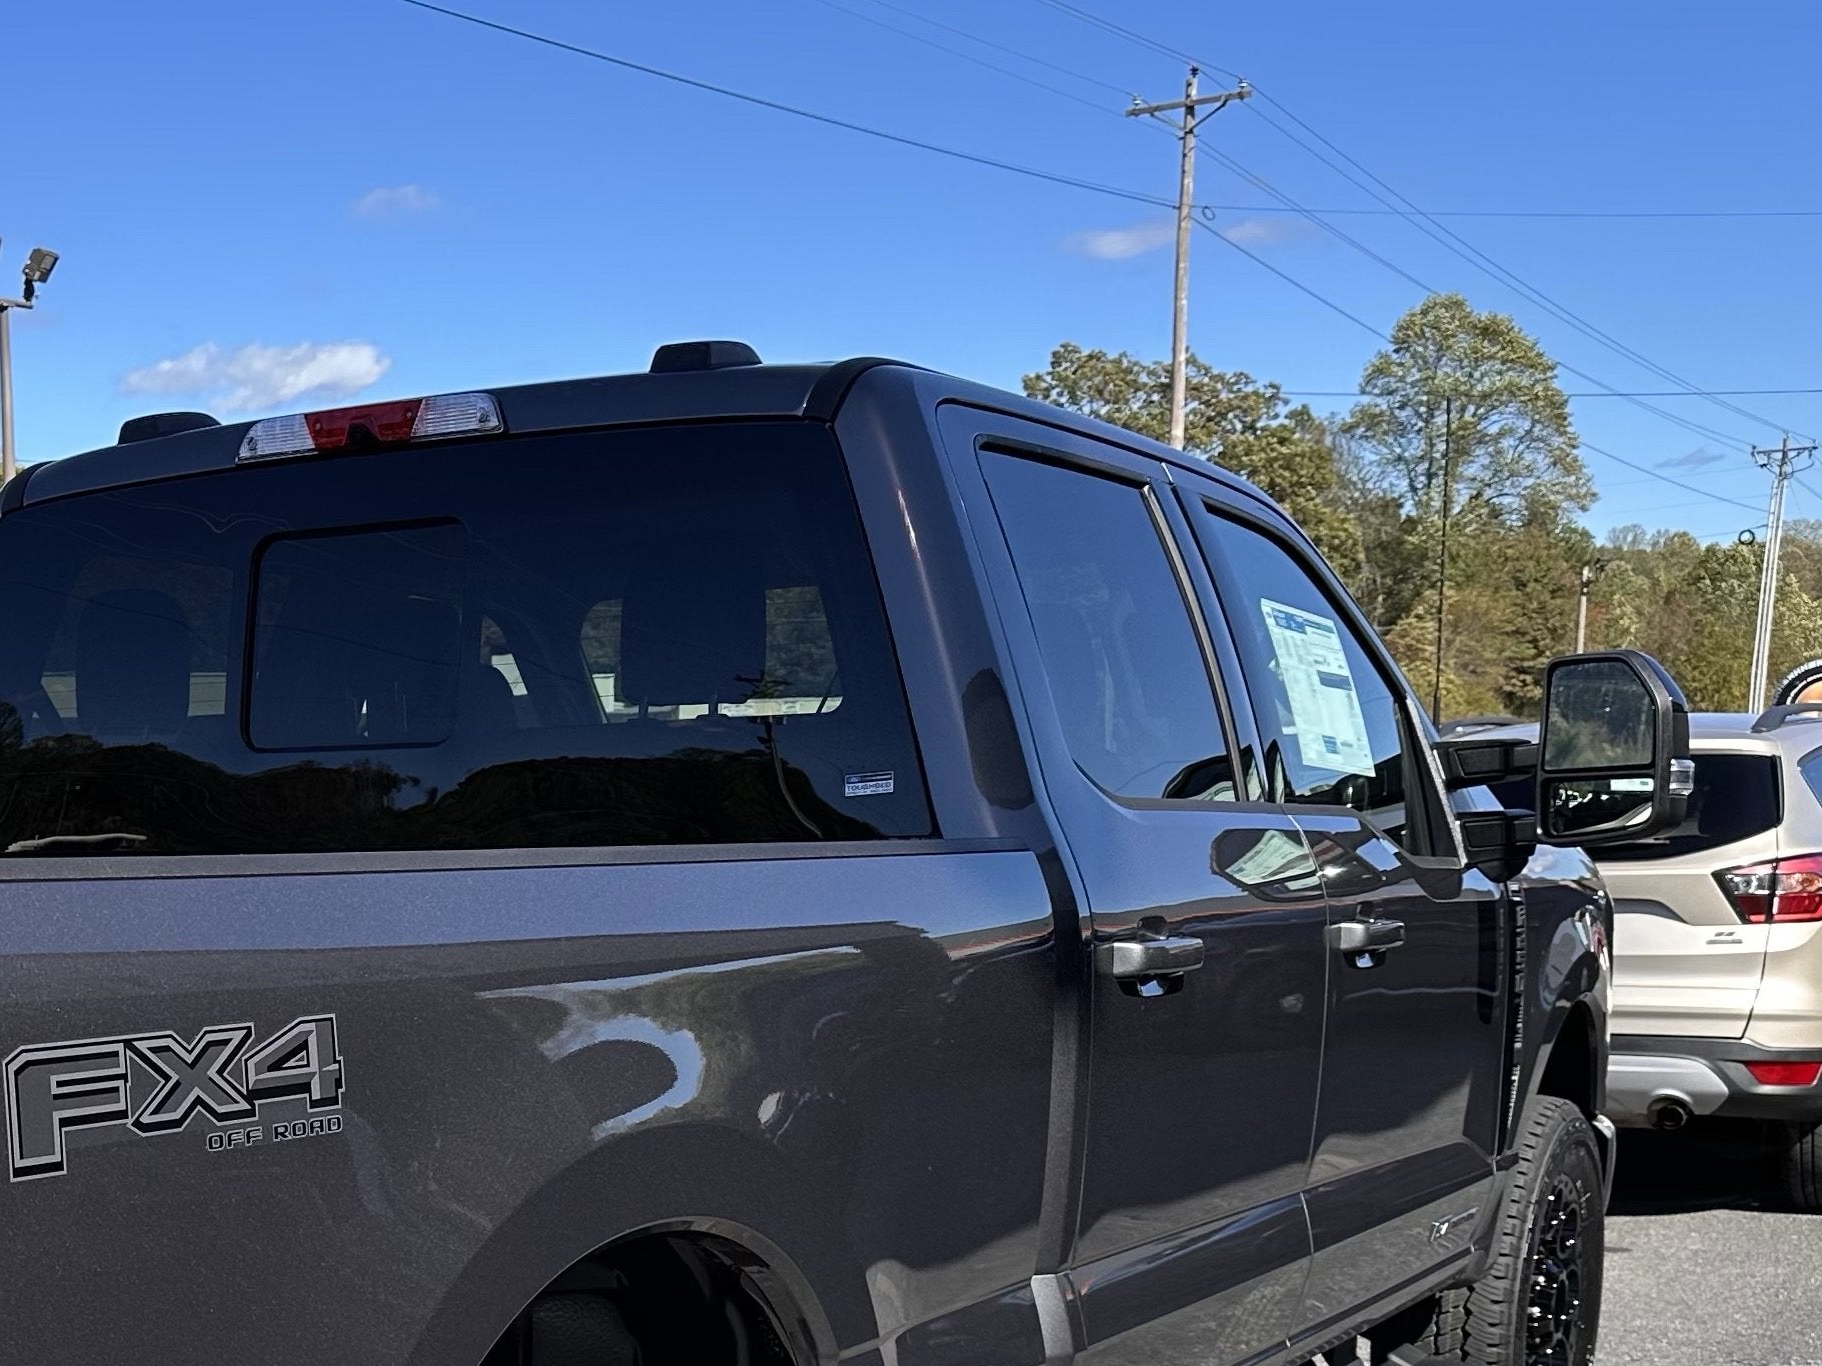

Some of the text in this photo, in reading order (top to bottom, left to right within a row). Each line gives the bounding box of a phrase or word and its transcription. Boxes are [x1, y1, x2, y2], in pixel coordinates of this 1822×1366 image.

[3, 1013, 344, 1182] FX4
[206, 1114, 344, 1152] OFF ROAD
